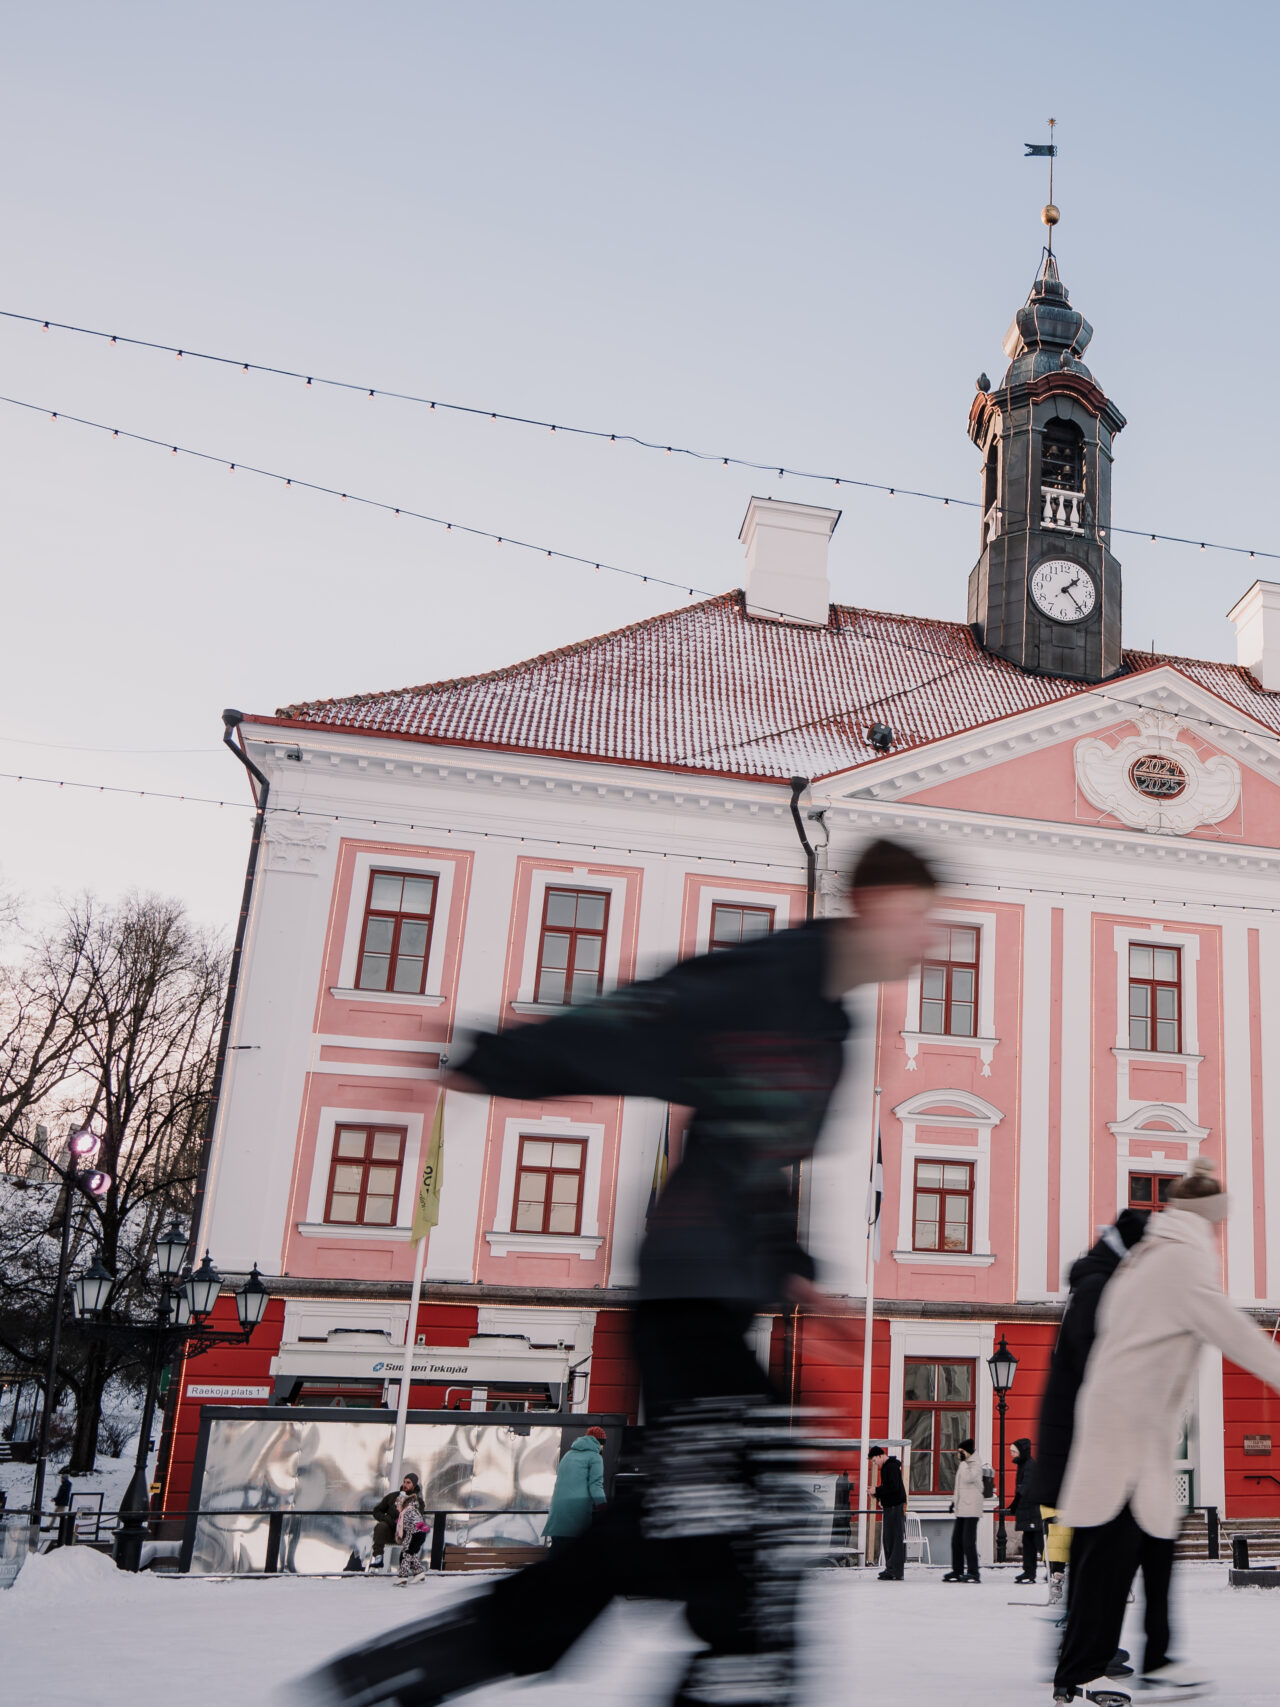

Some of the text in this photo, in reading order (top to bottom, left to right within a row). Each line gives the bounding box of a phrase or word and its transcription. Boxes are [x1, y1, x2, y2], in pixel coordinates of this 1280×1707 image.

[1049, 566, 1058, 575] 11
[1060, 565, 1071, 574] 12
[1041, 573, 1052, 582] 10
[1036, 582, 1044, 590] 9
[1082, 580, 1089, 588] 2
[1039, 593, 1047, 601] 8
[1085, 591, 1092, 599] 3
[1048, 602, 1055, 611] 7
[1060, 609, 1067, 617] 6
[1139, 758, 1180, 775] 2024
[1140, 777, 1179, 792] 2025
[191, 1387, 229, 1396] Raekoja
[231, 1388, 253, 1396] plats
